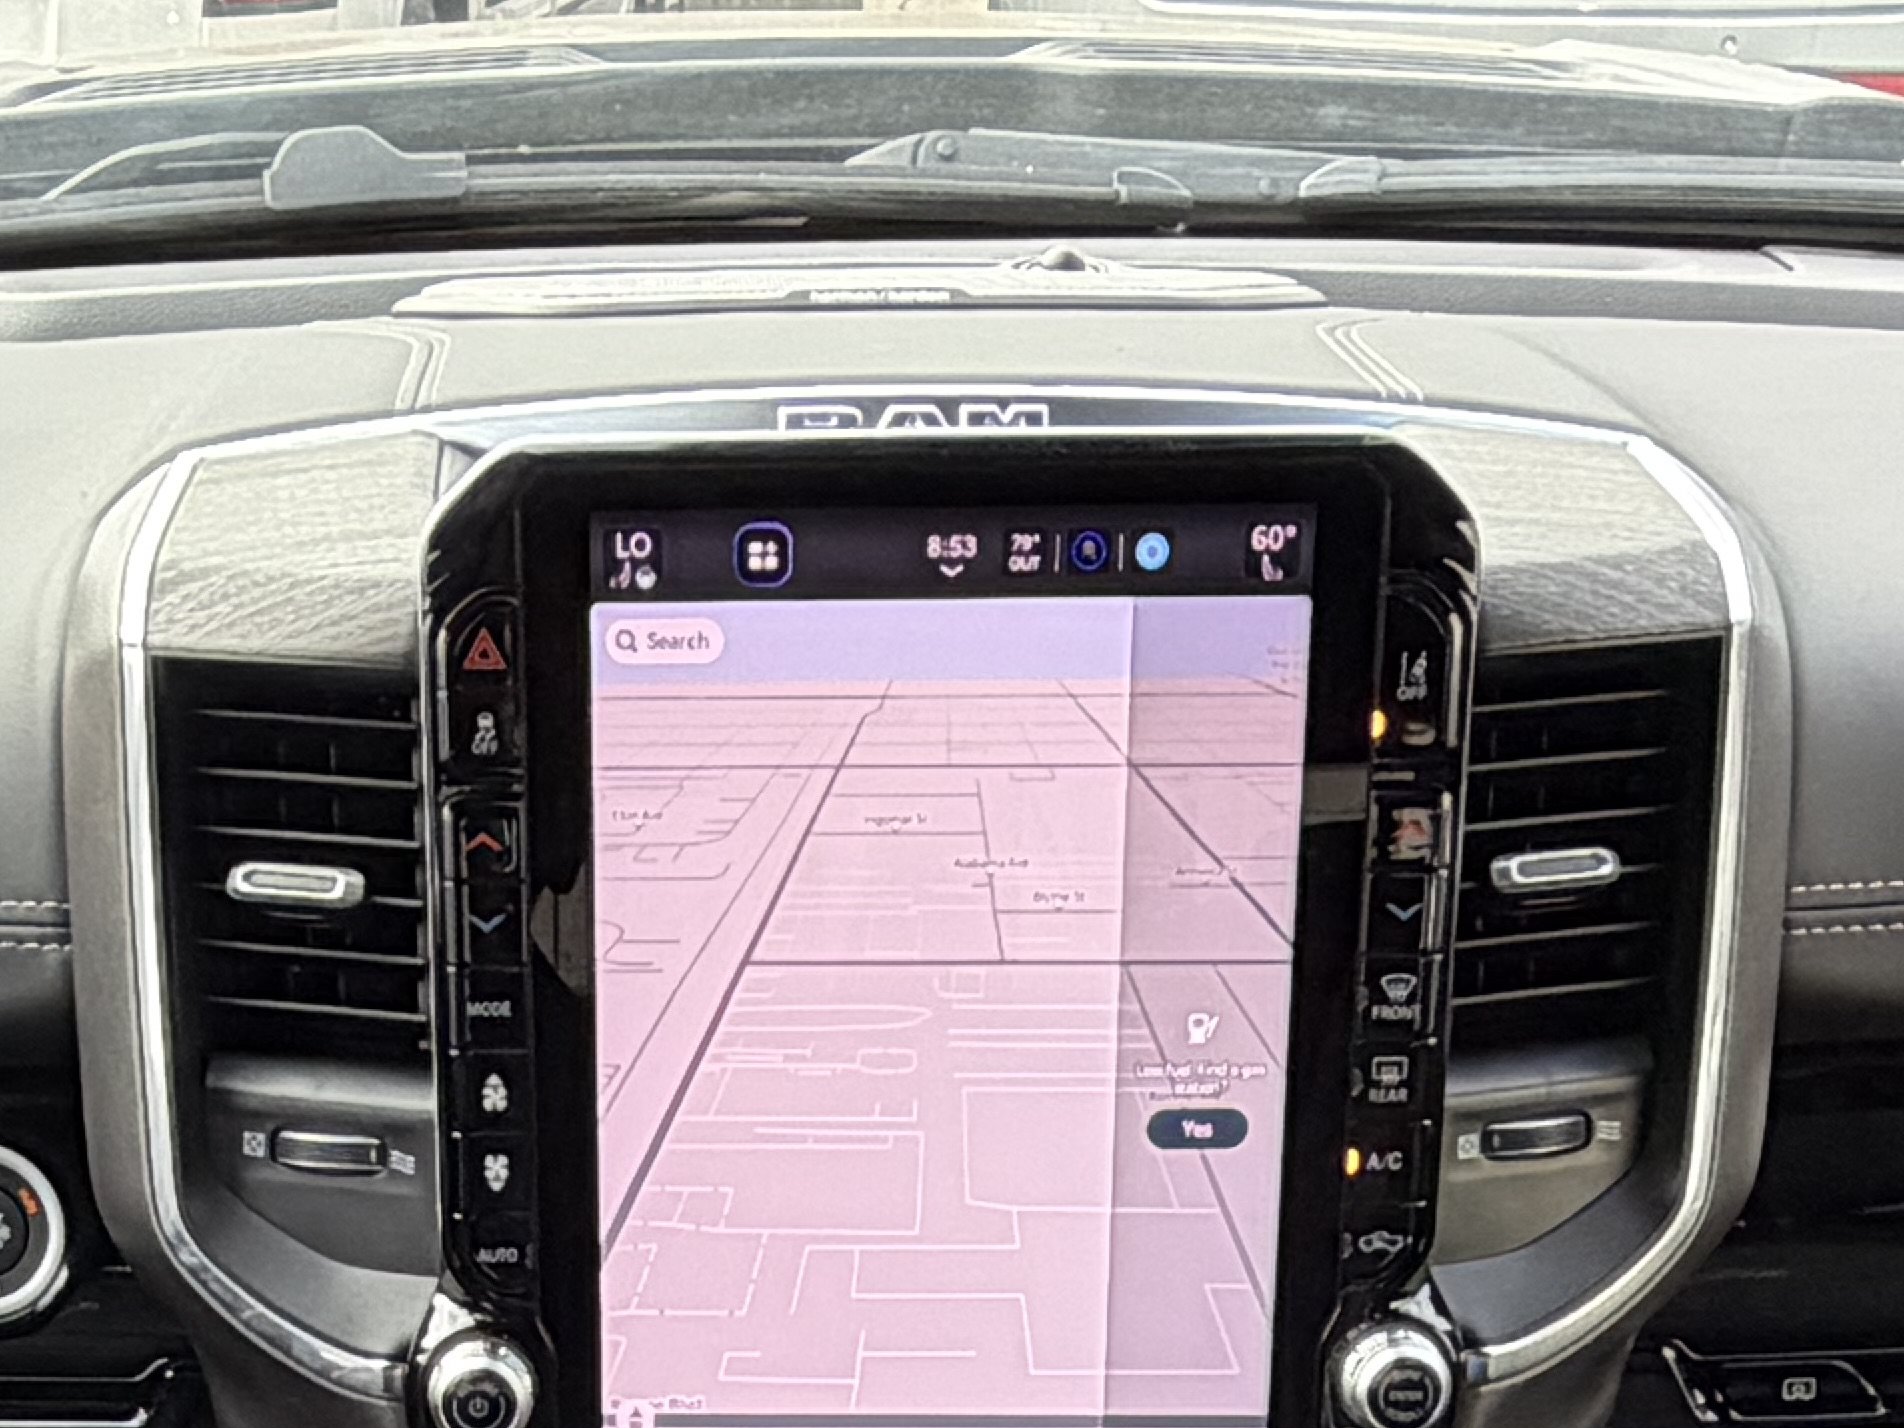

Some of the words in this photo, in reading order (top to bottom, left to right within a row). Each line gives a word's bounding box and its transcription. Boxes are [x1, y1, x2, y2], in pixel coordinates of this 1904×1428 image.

[614, 531, 652, 558] LO
[926, 534, 978, 559] 8:53
[1250, 524, 1297, 552] 60°
[1008, 554, 1041, 572] OUT
[646, 630, 710, 651] Search
[1371, 1004, 1421, 1020] FRONT
[1182, 1119, 1214, 1138] Yes
[1365, 1150, 1404, 1171] A/C
[476, 1246, 519, 1263] AUTO
